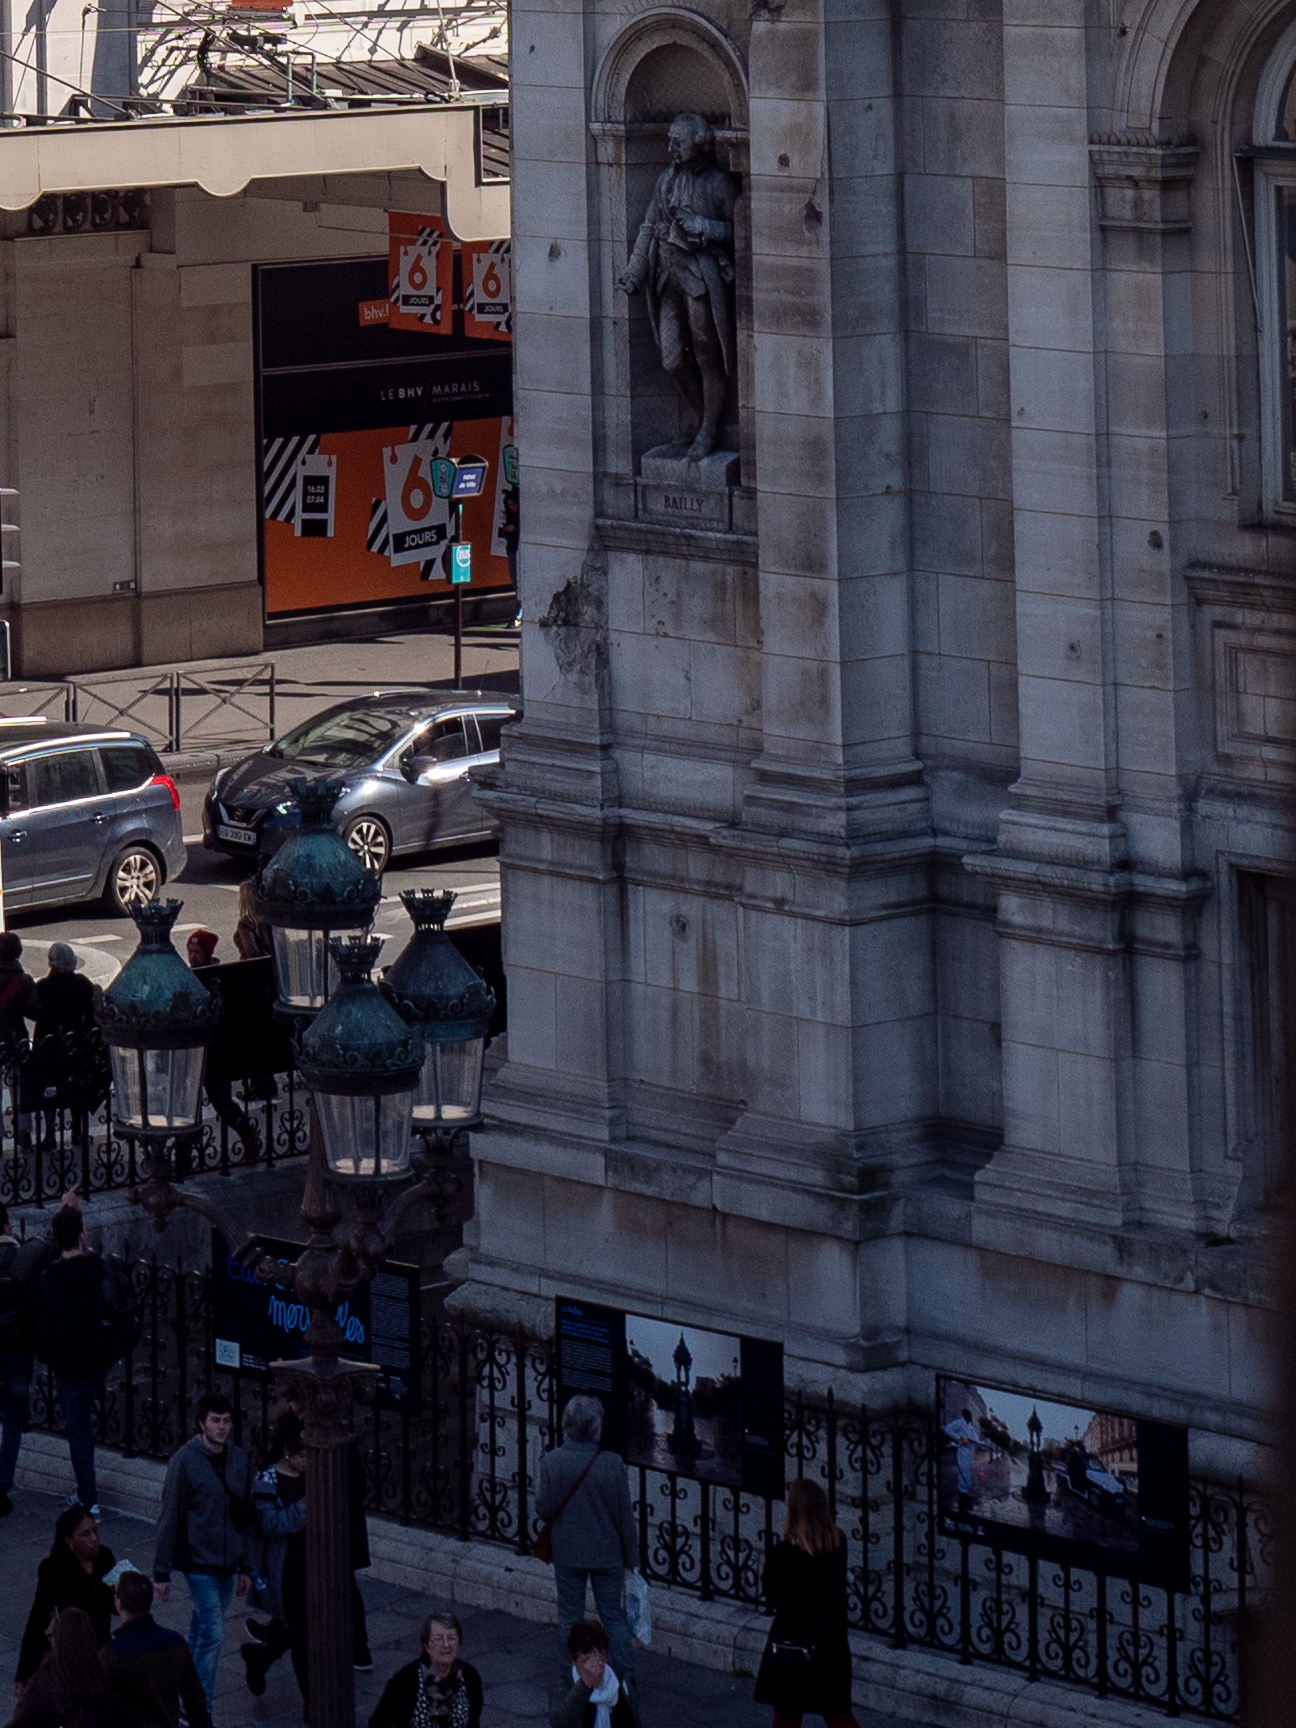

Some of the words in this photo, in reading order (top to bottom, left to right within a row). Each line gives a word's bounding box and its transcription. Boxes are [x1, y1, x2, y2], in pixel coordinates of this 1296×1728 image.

[408, 253, 428, 291] 6
[482, 261, 503, 299] 6
[409, 297, 429, 305] JOURS
[397, 386, 424, 400] BHV
[431, 380, 481, 397] MARAIS
[401, 454, 433, 522] 6
[664, 493, 704, 512] BAILLY
[403, 530, 438, 549] JOURS
